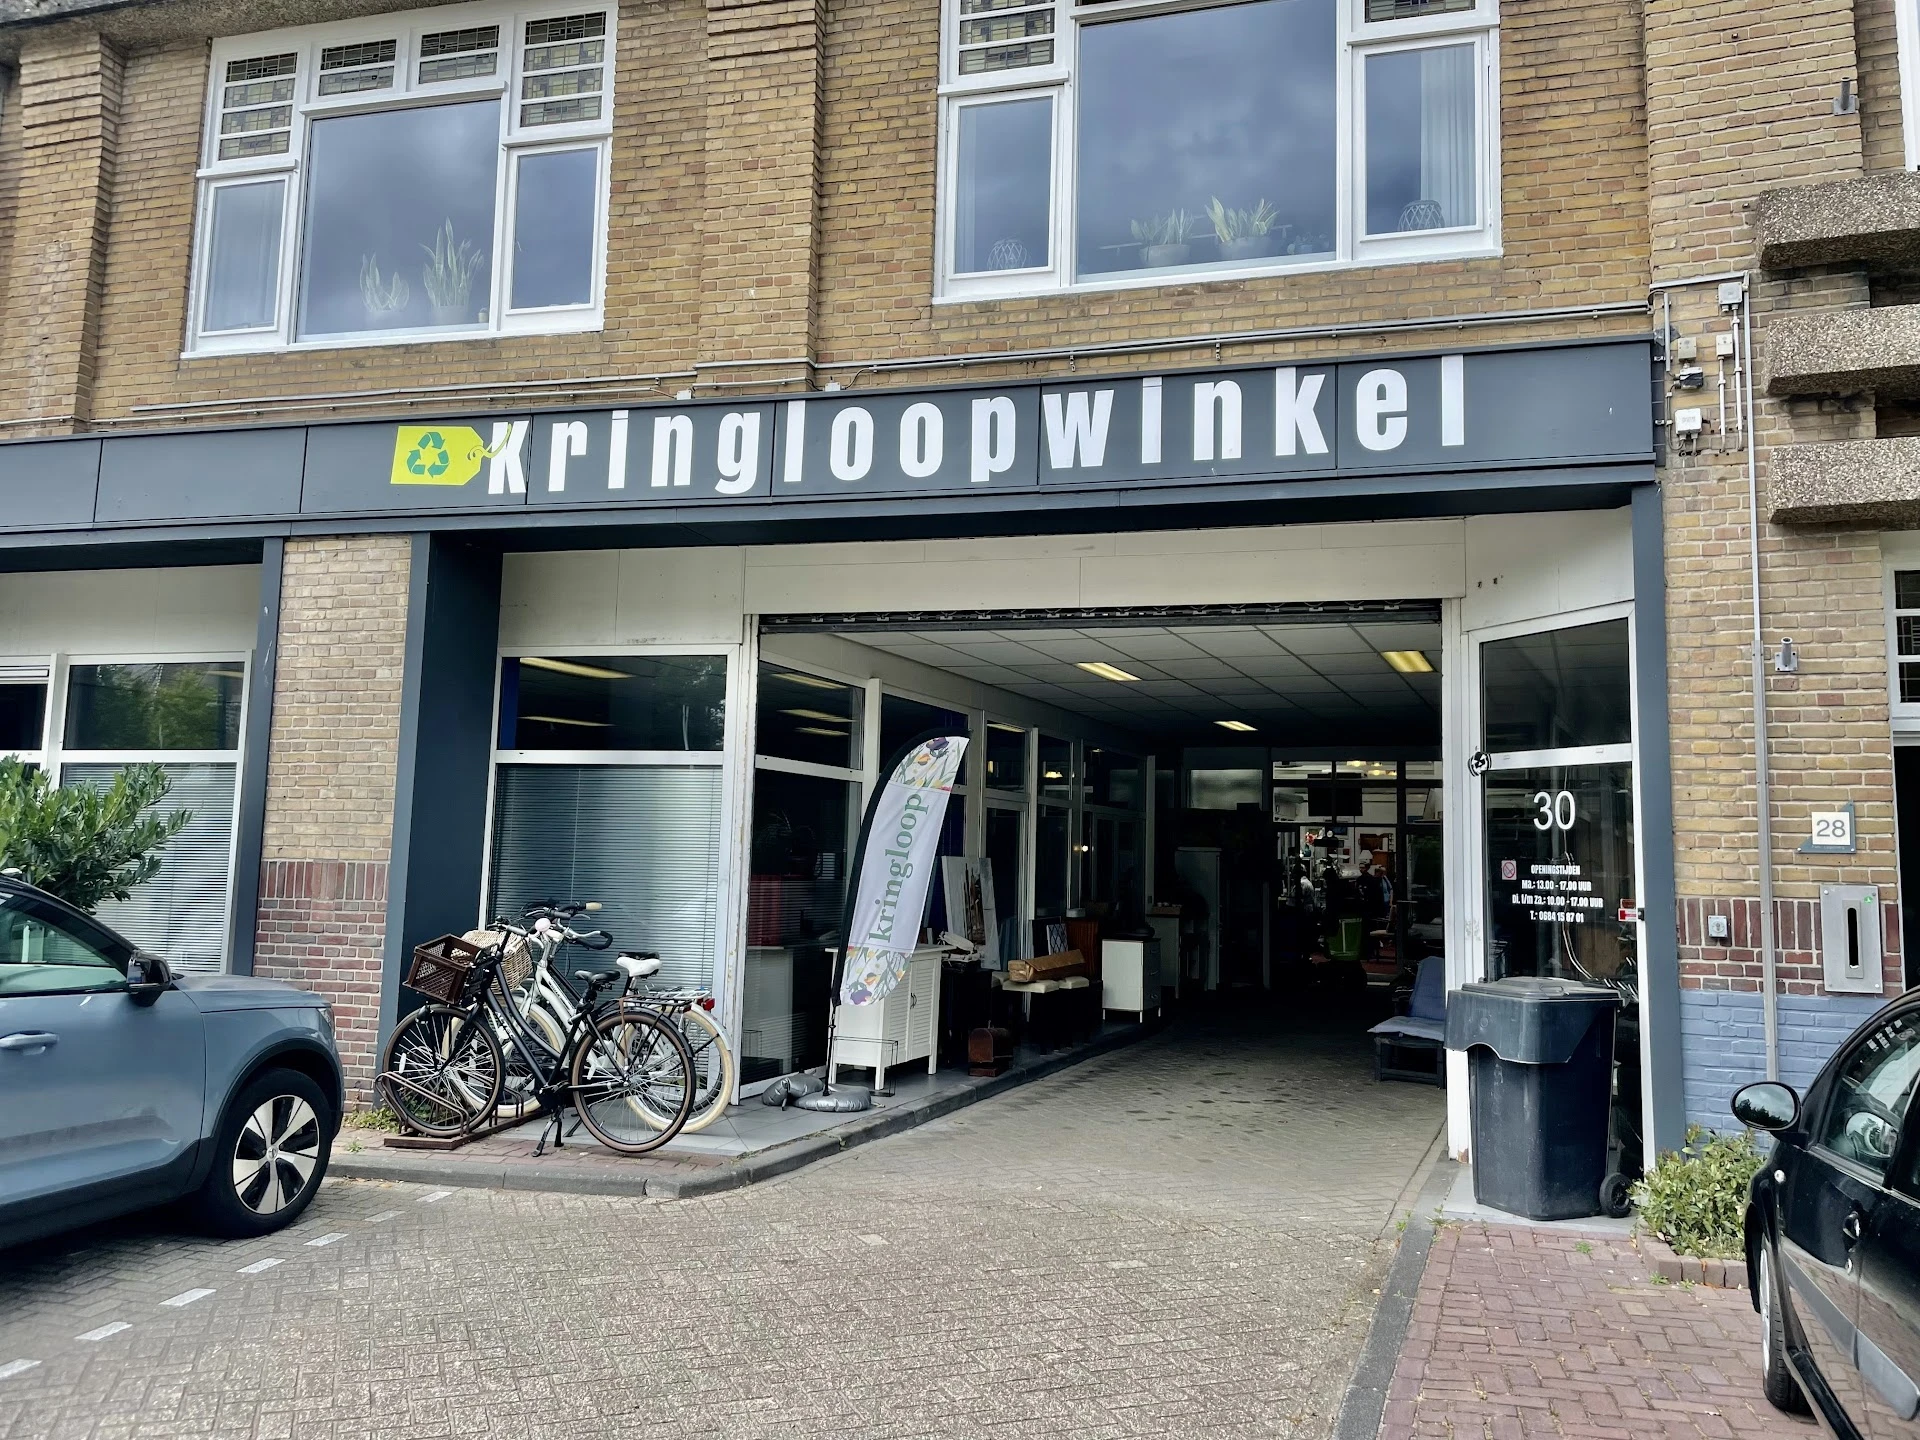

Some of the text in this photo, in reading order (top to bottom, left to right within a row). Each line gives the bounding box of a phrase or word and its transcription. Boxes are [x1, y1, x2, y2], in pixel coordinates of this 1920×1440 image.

[1533, 790, 1576, 831] 30
[1816, 819, 1846, 838] 28
[868, 793, 929, 943] kringloop
[1531, 865, 1580, 875] OPENINGSTIJDEN
[1537, 880, 1554, 889] 13.00
[1560, 881, 1577, 890] 17.00
[1578, 882, 1591, 891] UUR
[1547, 896, 1565, 905] 10.00
[1570, 897, 1588, 906] 17.00
[1590, 897, 1603, 907] UUR
